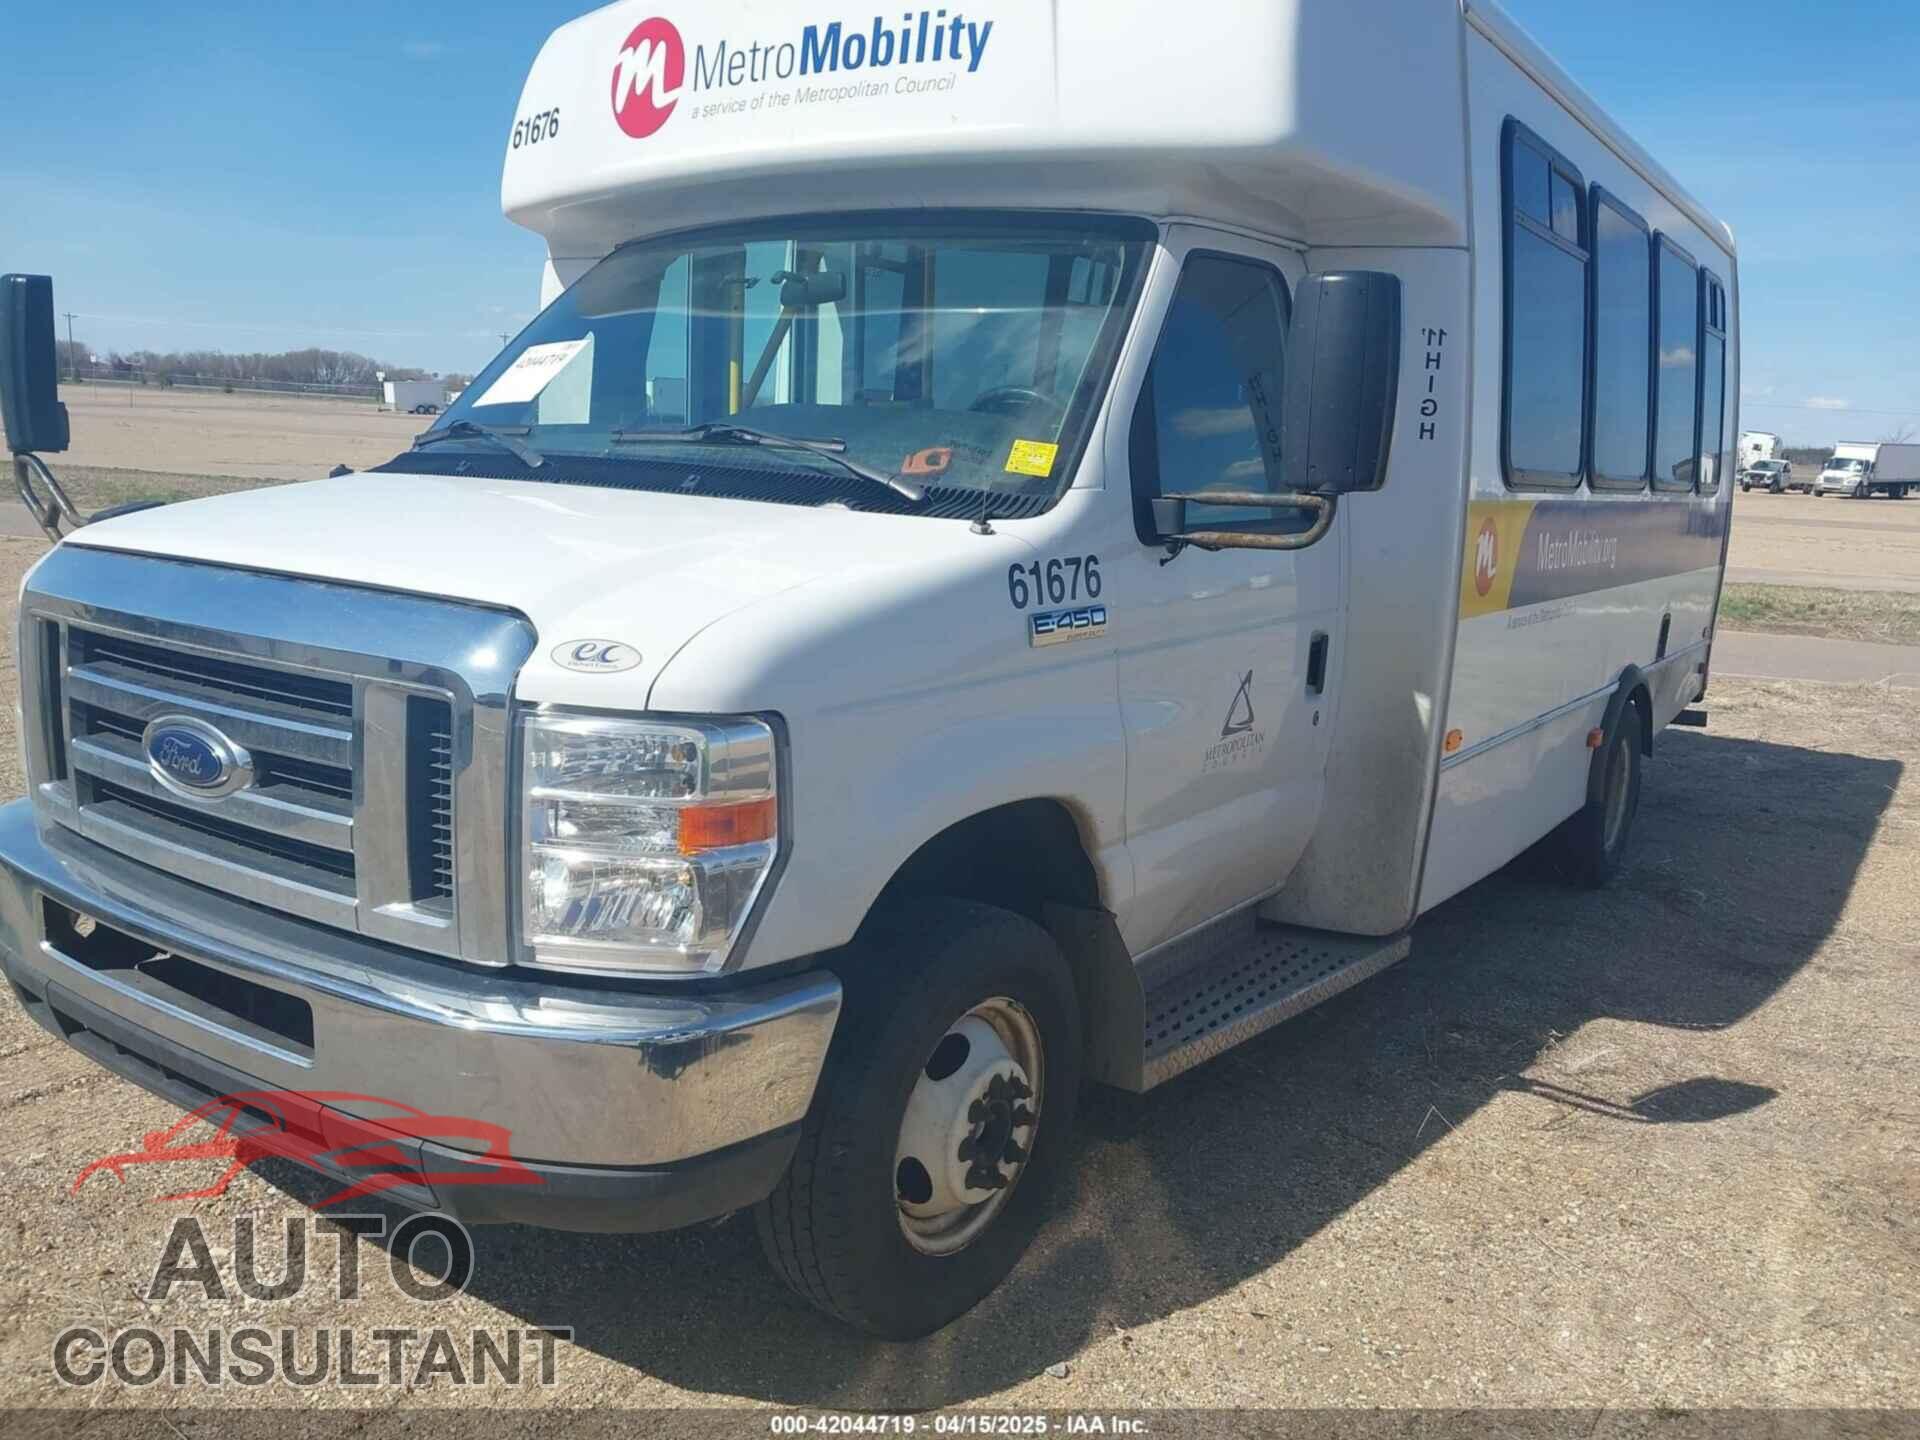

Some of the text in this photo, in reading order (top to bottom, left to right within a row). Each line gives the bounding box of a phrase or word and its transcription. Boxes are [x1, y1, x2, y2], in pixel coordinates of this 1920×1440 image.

[693, 9, 994, 92] MetroMobility
[702, 99, 747, 118] service
[750, 92, 766, 110] of
[768, 89, 790, 108] the
[795, 80, 889, 104] Metropolitan
[895, 71, 957, 94] Council
[513, 106, 560, 150] 61676
[1008, 554, 1102, 609] 61676
[1033, 607, 1106, 635] E-450
[160, 736, 203, 775] Ford
